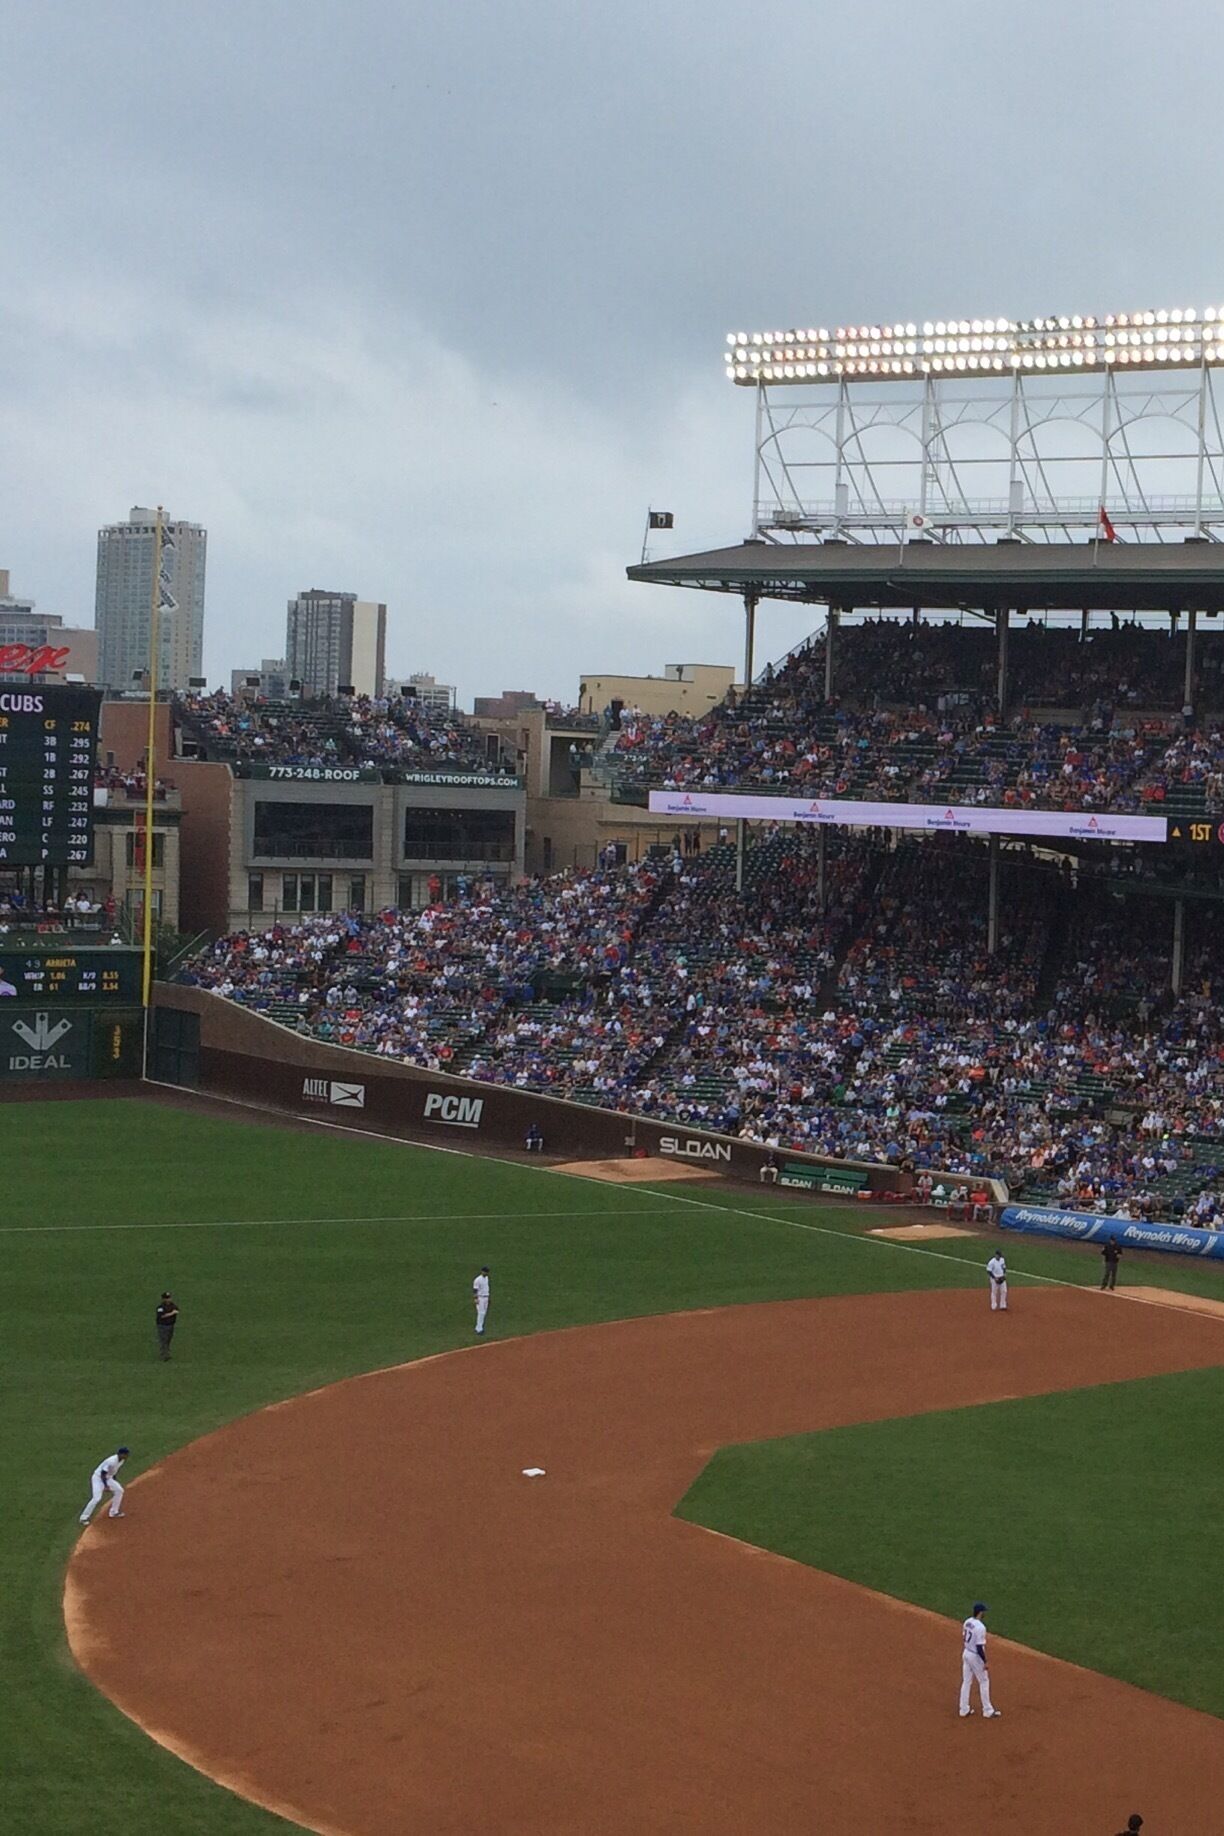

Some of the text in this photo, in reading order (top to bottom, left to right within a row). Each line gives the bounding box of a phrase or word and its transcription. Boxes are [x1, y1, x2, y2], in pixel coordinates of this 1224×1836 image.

[0, 693, 43, 713] CUBS
[44, 719, 57, 730] CF
[70, 721, 91, 732] .274
[44, 736, 57, 747] 3B
[69, 738, 90, 748] .295
[44, 752, 90, 764] 1B .292
[43, 769, 56, 779] 2B
[68, 770, 89, 780] .267
[269, 766, 360, 781] 773-248-ROOF
[405, 772, 518, 787] WRIGLEYROOFTOPS.COM
[42, 785, 54, 795] SS
[68, 786, 89, 796] .245
[42, 801, 55, 810] RF
[68, 802, 89, 812] .232
[42, 817, 54, 827] LF
[68, 818, 88, 828] .247
[1189, 823, 1212, 841] 1ST
[42, 833, 49, 843] C
[67, 835, 88, 845] .220
[41, 849, 49, 859] P
[67, 850, 87, 860] .267
[9, 1054, 72, 1071] IDEAL
[303, 1078, 329, 1098] ALTEC
[423, 1093, 484, 1122] PCM
[659, 1136, 732, 1162] SLOAN
[780, 1177, 812, 1189] SLOAN
[821, 1183, 855, 1195] SLOAN
[1015, 1209, 1088, 1231] Reynolds Wrap
[1124, 1225, 1201, 1249] Reynolds Wrap
